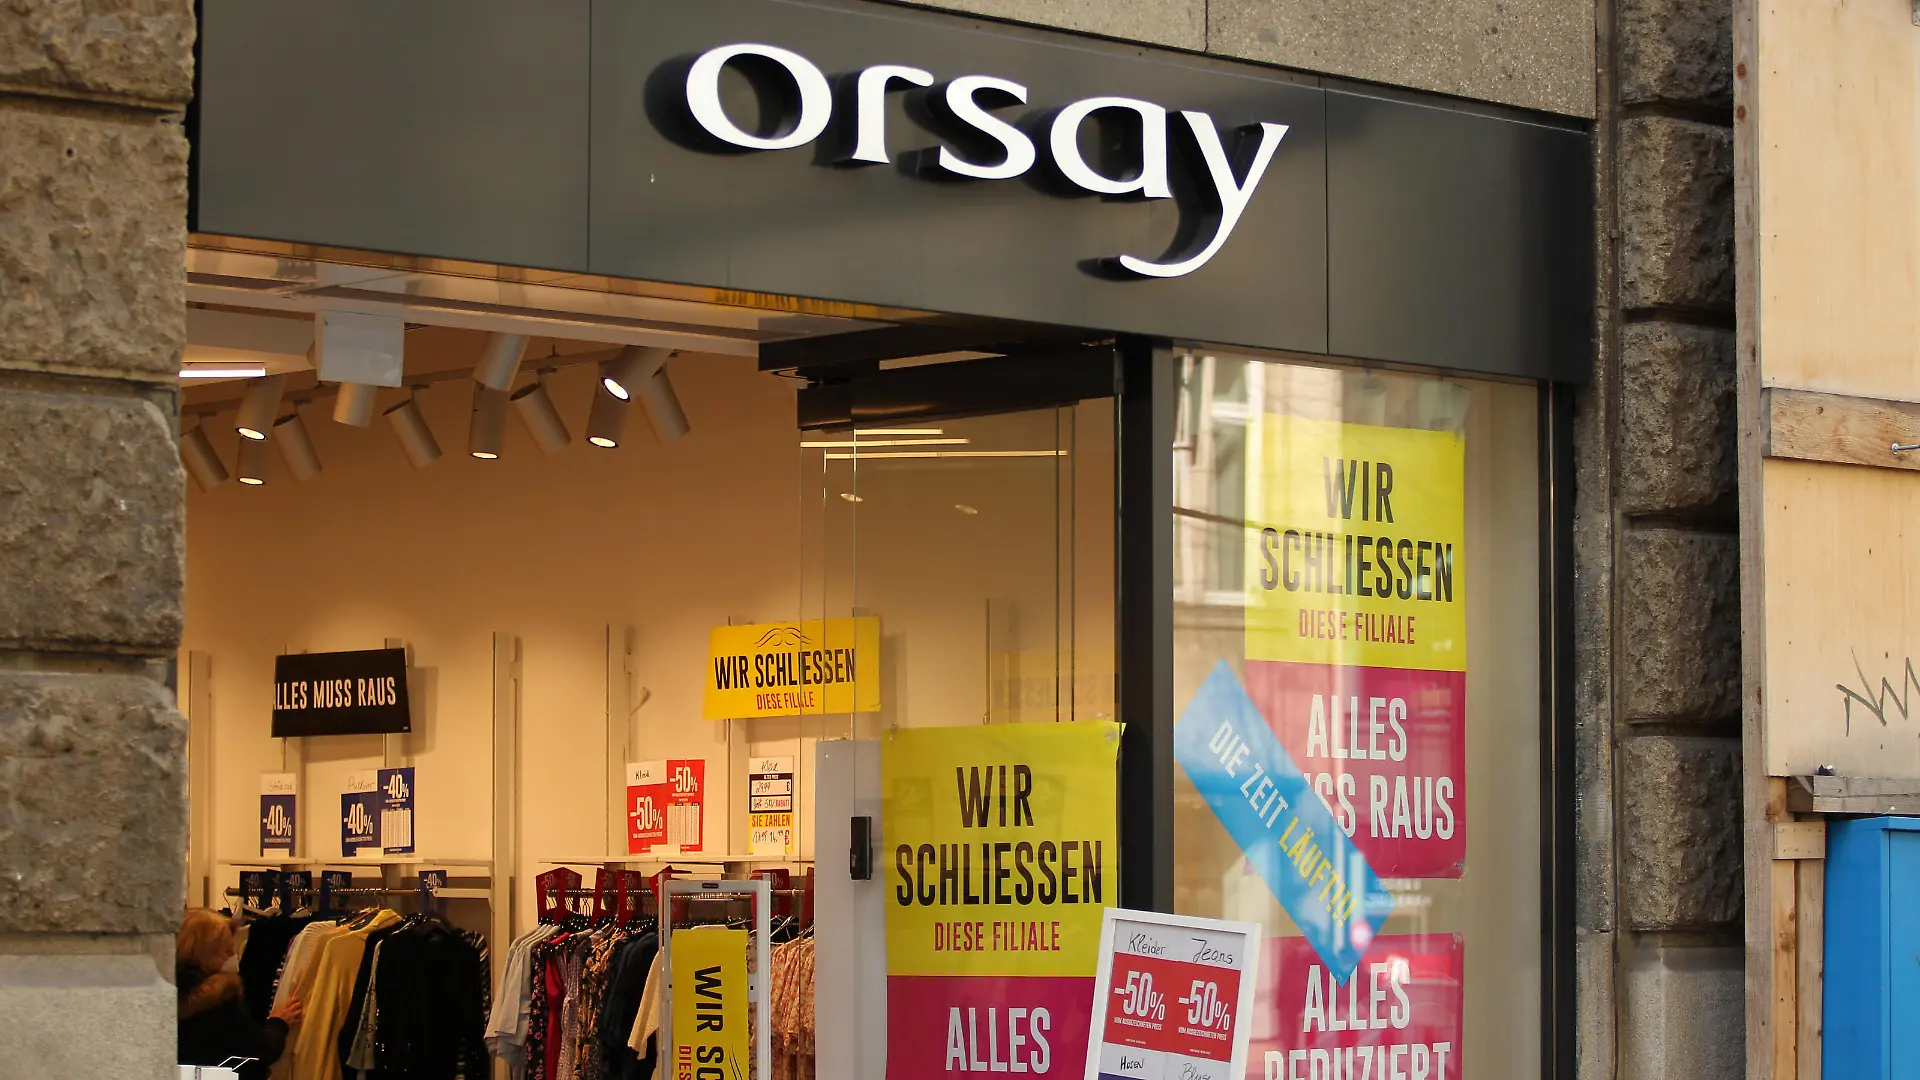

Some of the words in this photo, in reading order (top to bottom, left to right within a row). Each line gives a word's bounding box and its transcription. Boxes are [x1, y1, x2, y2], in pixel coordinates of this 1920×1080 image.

[686, 43, 1290, 278] orsay
[1322, 456, 1394, 524] WIR
[1260, 527, 1453, 603] SCHLIESSEN
[1298, 608, 1347, 640] DIESE
[1355, 612, 1416, 645] FILIALE
[714, 655, 750, 690] WIR
[754, 648, 856, 689] SCHLIESSEN
[313, 679, 352, 709] MUSS
[357, 676, 397, 707] RAUS
[756, 693, 783, 711] DIESE
[1306, 694, 1407, 761] ALLES
[383, 774, 409, 798] -40%
[669, 766, 698, 793] -50%
[1208, 717, 1250, 778] DIE
[1239, 762, 1289, 829] ZEIT
[344, 803, 374, 834] -40%
[630, 796, 663, 830] -50%
[956, 764, 1034, 829] WIR
[1303, 772, 1356, 839] SS
[1370, 774, 1455, 840] RAUS
[263, 805, 292, 837] -40%
[751, 814, 763, 828] SIE
[765, 814, 791, 827] ZAHLEN
[895, 840, 1102, 906] SCHLIESSEN
[934, 921, 984, 952] DIESE
[992, 920, 1060, 952] FILIALE
[1128, 931, 1166, 956] Kleider
[1191, 938, 1233, 965] Jeans
[694, 965, 724, 1033] WIR
[1114, 970, 1166, 1021] -50%
[1178, 979, 1230, 1031] -50%
[1303, 959, 1411, 1033] ALLES
[945, 1006, 1051, 1075] ALLES
